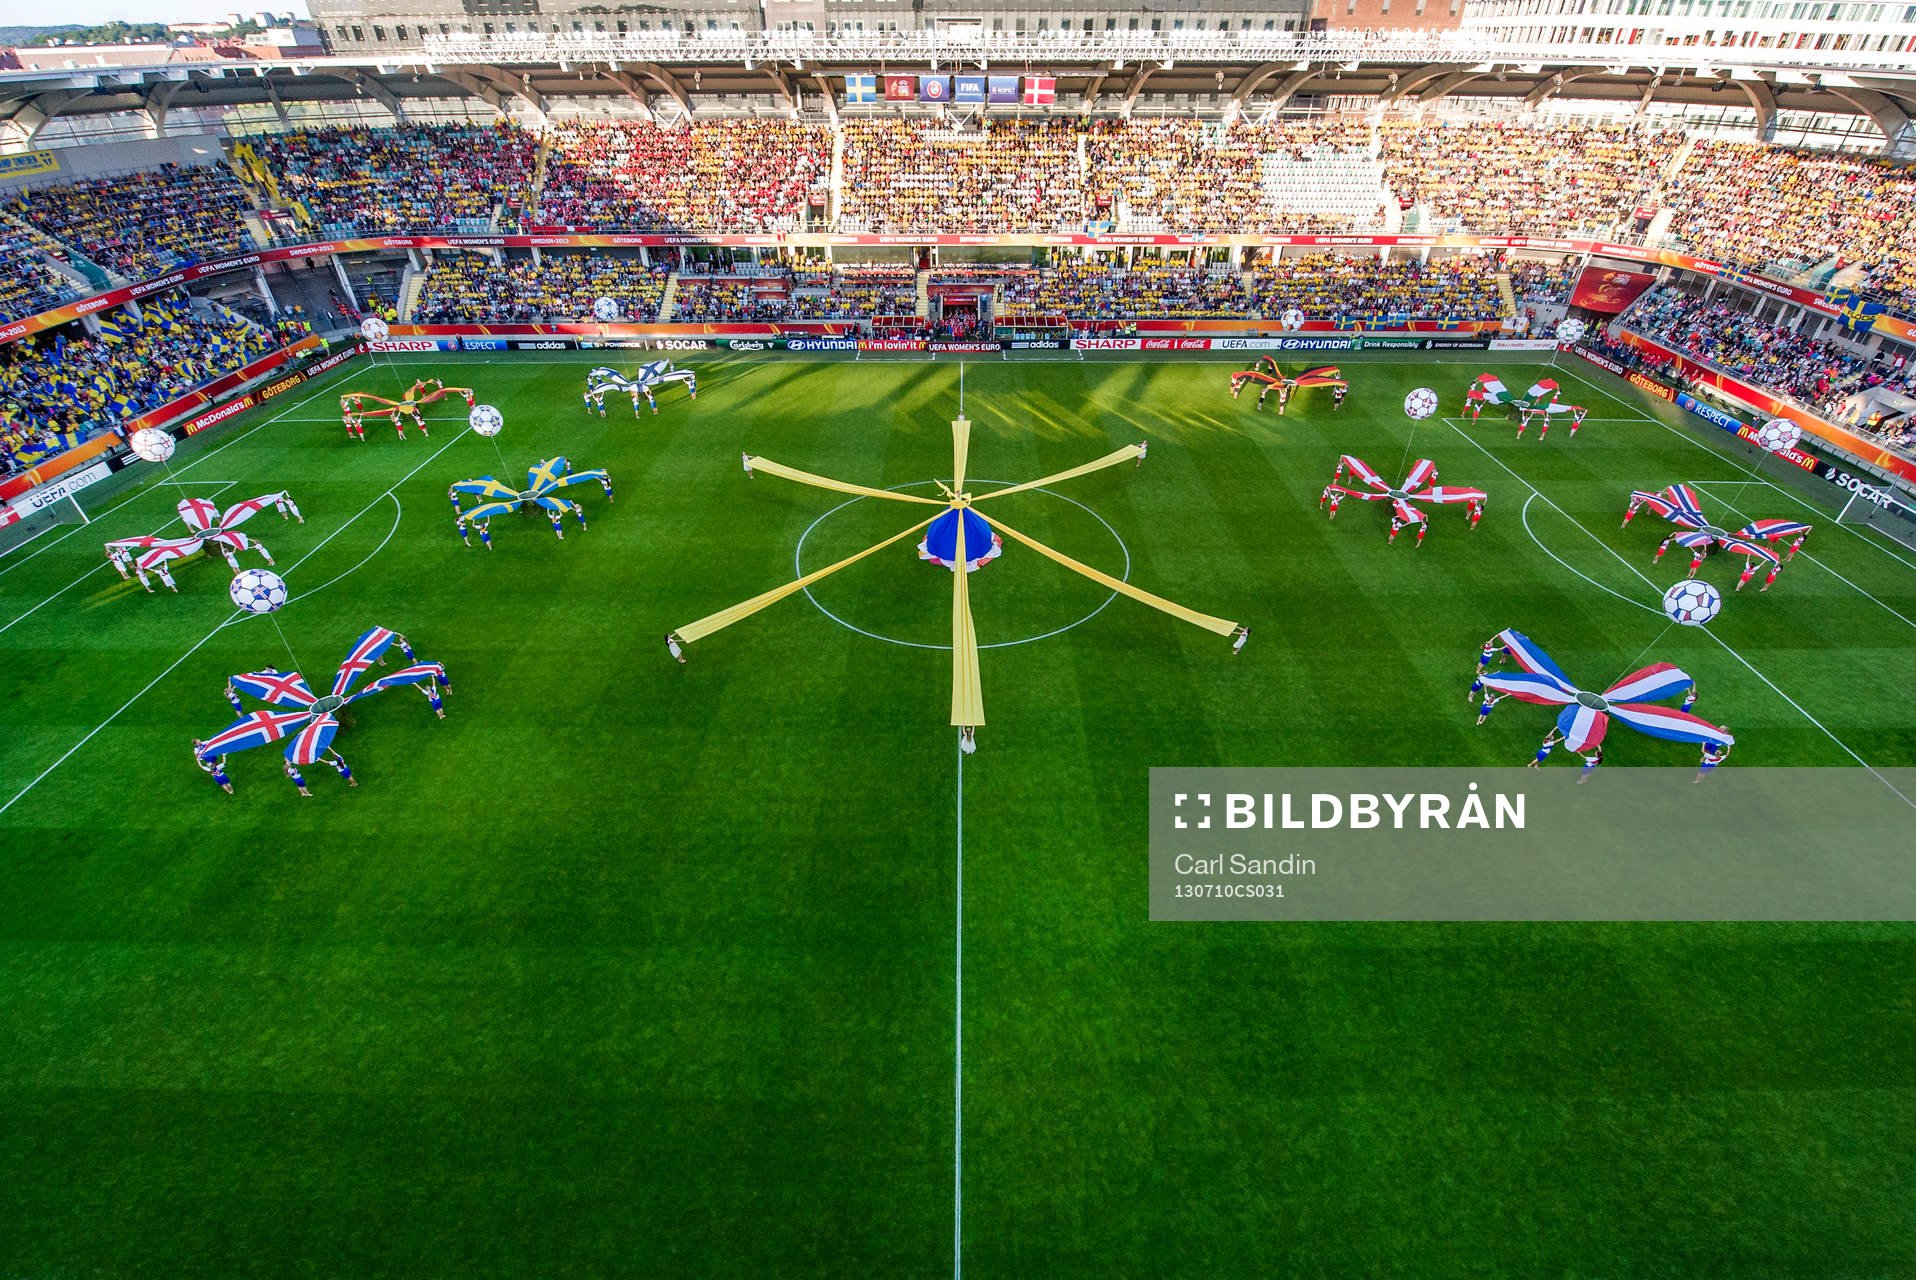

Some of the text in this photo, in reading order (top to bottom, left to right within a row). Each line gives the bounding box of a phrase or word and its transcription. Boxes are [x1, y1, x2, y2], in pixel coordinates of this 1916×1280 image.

[960, 83, 979, 92] FIFA
[198, 265, 215, 274] UEFA
[243, 256, 260, 264] EURO
[1694, 261, 1719, 272] GÖTEBO
[130, 285, 147, 295] UEFA
[373, 341, 433, 351] SHARP
[464, 342, 496, 350] ESPECT
[536, 341, 566, 350] adidas
[665, 340, 707, 350] SOCAR
[729, 340, 764, 351] Carlsberg
[807, 341, 858, 350] HYUNDAI
[981, 343, 1000, 351] EURO
[1030, 341, 1060, 349] adidas
[1076, 339, 1136, 349] SHARP
[1300, 340, 1351, 349] HYUNDAI
[1575, 346, 1586, 357] UEFA
[306, 365, 322, 376] UEFA
[262, 375, 301, 399] GÖTEBORG
[1629, 373, 1668, 398] GÖTEBORG
[195, 401, 245, 429] McDonald's
[1694, 403, 1731, 427] RESPECT
[1835, 472, 1893, 509] SOCAR
